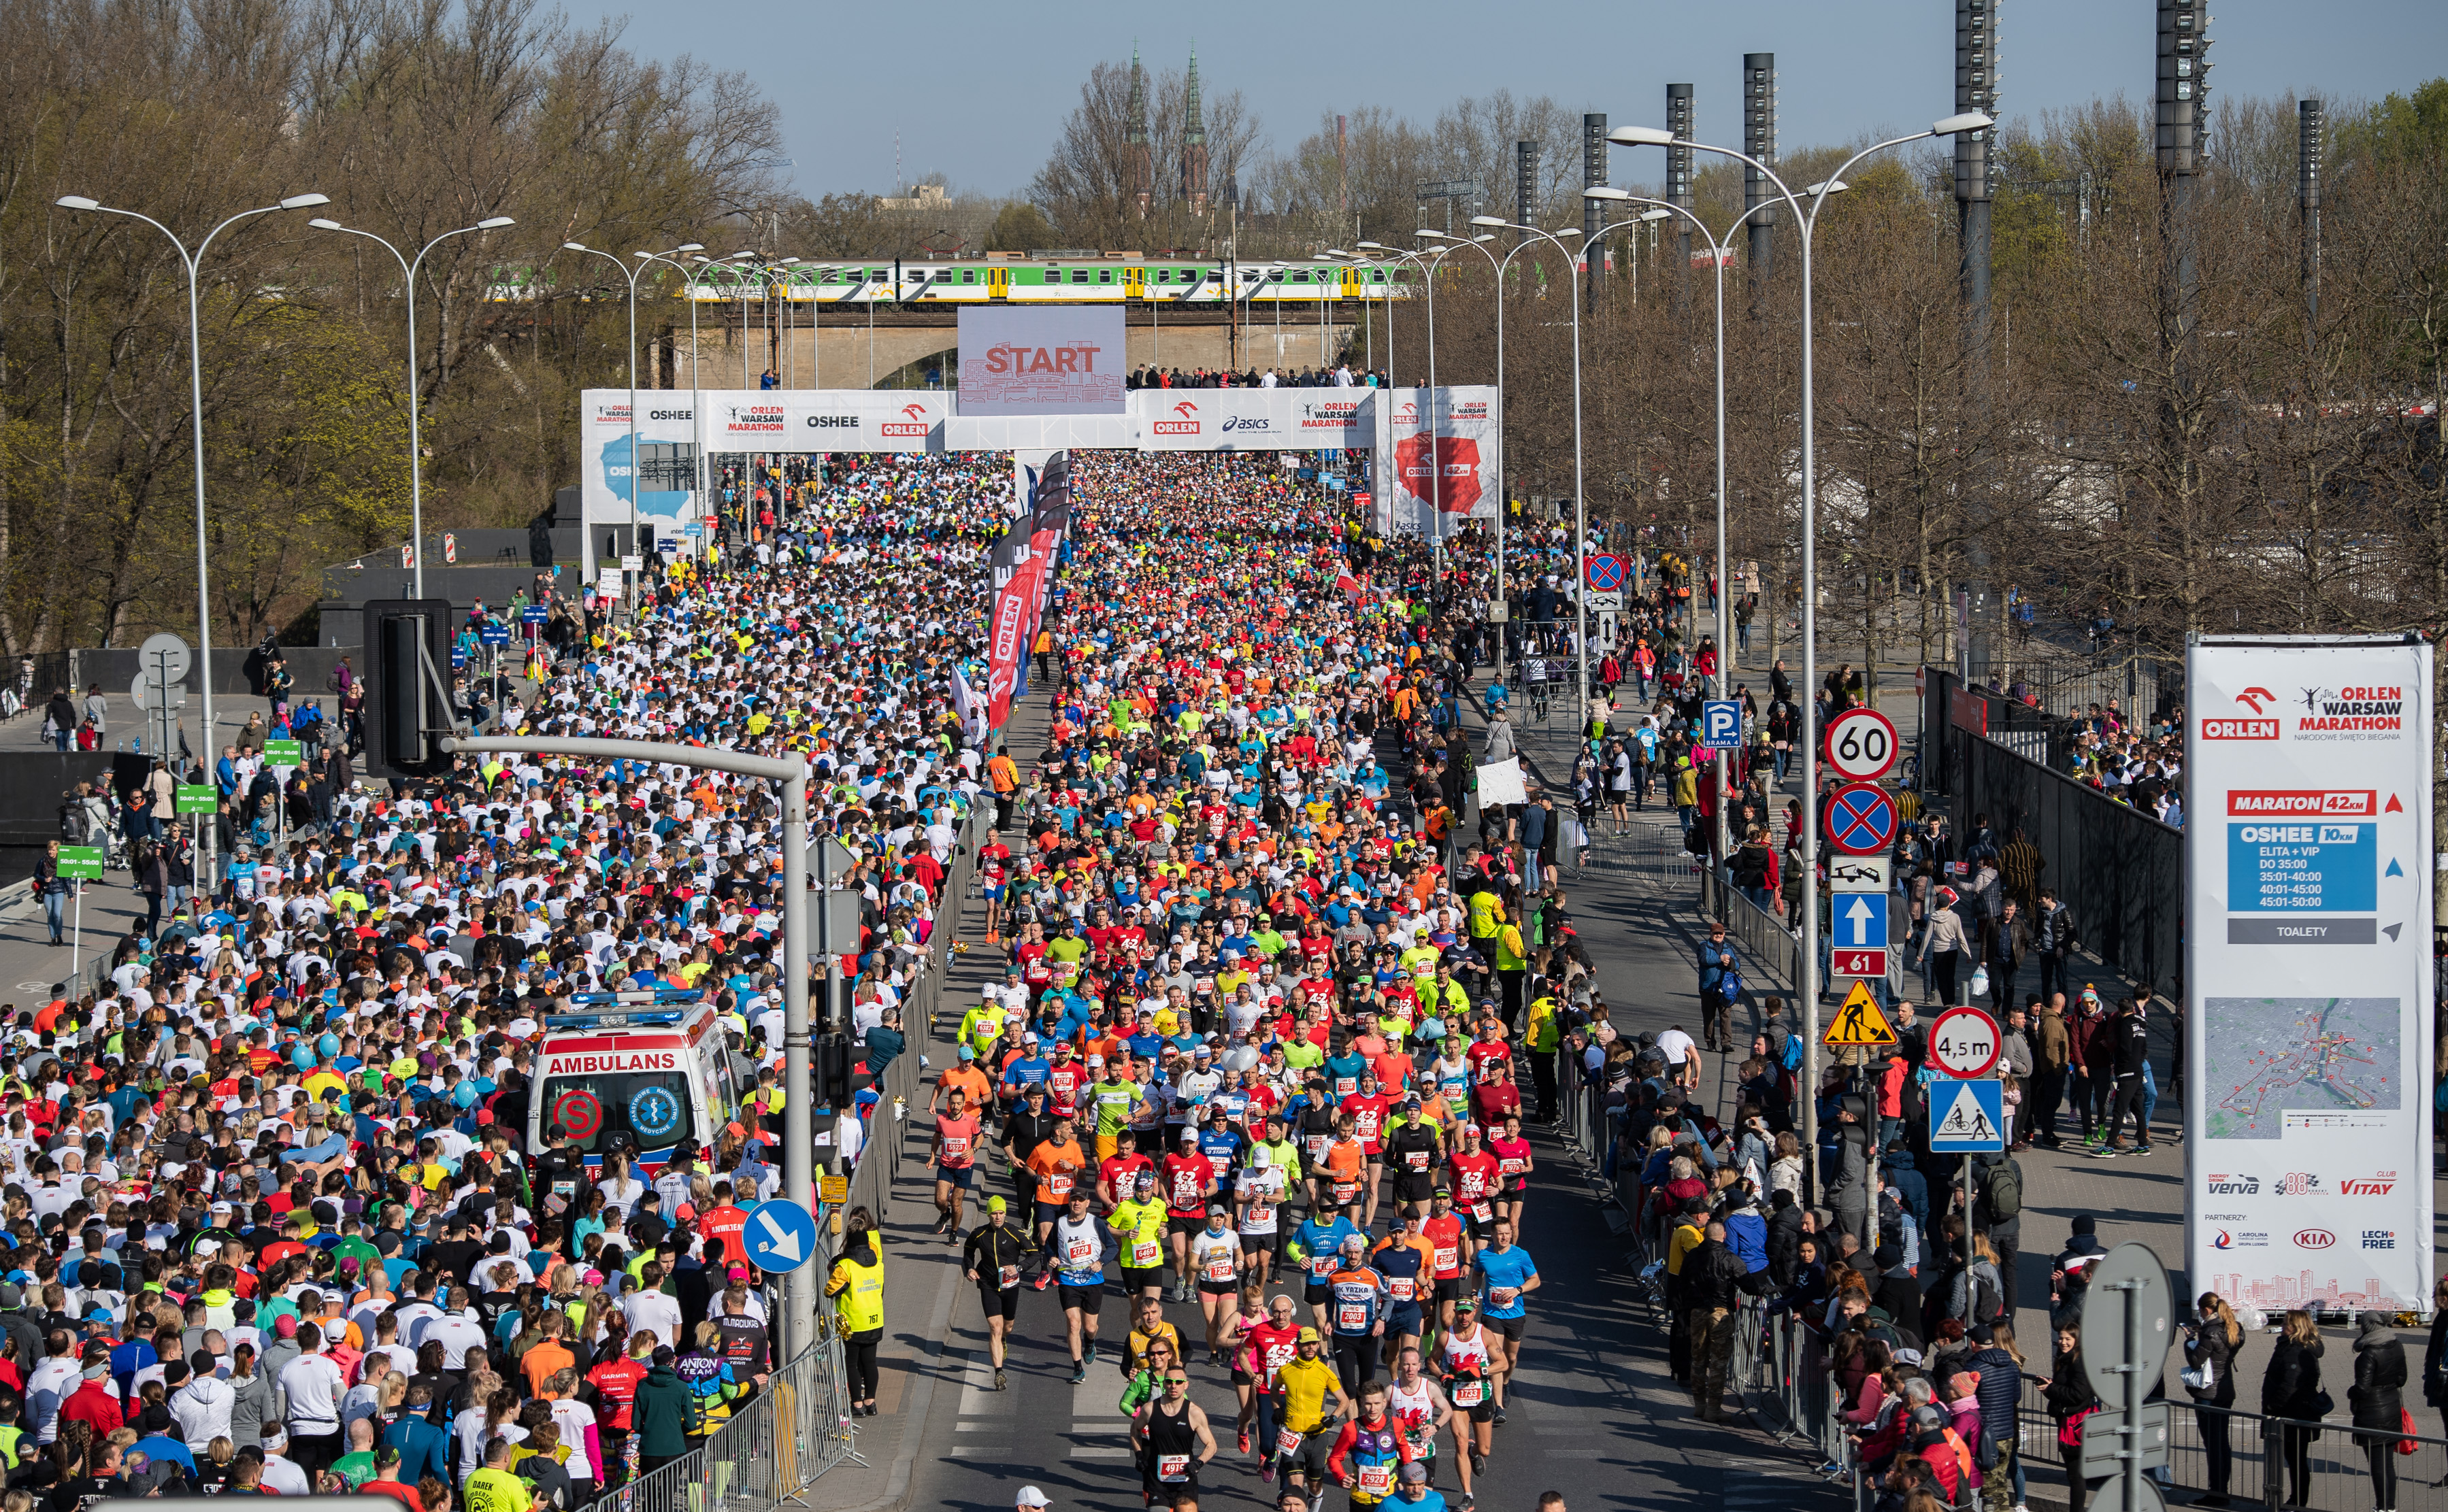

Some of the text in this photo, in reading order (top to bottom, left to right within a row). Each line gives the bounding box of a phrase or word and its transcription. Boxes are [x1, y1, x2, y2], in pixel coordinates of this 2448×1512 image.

[985, 347, 1101, 373] START
[750, 406, 784, 414] ORLEN
[1324, 402, 1357, 411] ORLEN
[650, 410, 693, 420] OSHEE
[1314, 411, 1357, 419] WARSAW
[728, 423, 784, 431] MARATHON
[807, 416, 859, 428] OSHEE
[1238, 419, 1270, 429] asics
[1302, 419, 1357, 427] MARATHON
[884, 425, 926, 435] ORLEN
[1155, 422, 1197, 433] ORLEN
[999, 599, 1020, 657] ORLEN
[2341, 686, 2401, 701] ORLEN
[2323, 702, 2402, 716] WARSAW
[1711, 714, 1733, 737] P
[2299, 717, 2401, 730] MARATHON
[2205, 722, 2276, 737] ORLEN
[2339, 733, 2366, 742] ŚWIĘTO
[1839, 726, 1887, 761] 60
[2234, 796, 2364, 810] MARATON 42KM
[2240, 826, 2353, 843] OSHEE 10KM
[2260, 847, 2290, 856] ELITA
[2300, 847, 2320, 856] VIP
[2260, 860, 2307, 869] DO 35:00
[2260, 872, 2322, 881] 35:01-40:00
[2260, 885, 2322, 894] 40:01-45:00
[2260, 897, 2322, 907] 45:01-50:00
[2277, 927, 2328, 937] TOALETY
[1850, 954, 1869, 971] 61
[1938, 1037, 1991, 1059] 4,5 m
[548, 1054, 675, 1074] AMBULANS
[632, 1088, 651, 1122] PAŃSTWOWE
[656, 1088, 677, 1120] RATOWNICTWO
[565, 1100, 590, 1130] S
[640, 1124, 671, 1135] MEDYCZNE
[1057, 1179, 1071, 1187] 4118
[2285, 1172, 2309, 1196] 88
[2341, 1178, 2398, 1195] VITAY
[2209, 1183, 2260, 1194] verva
[2300, 1233, 2329, 1245] KIA
[2362, 1230, 2388, 1239] LECH
[2362, 1240, 2395, 1249] FREE
[1073, 1246, 1089, 1256] 2728
[1138, 1248, 1154, 1257] 6469
[868, 1314, 878, 1324] 767
[1344, 1313, 1362, 1321] 2003
[680, 1358, 718, 1368] ANTON
[1460, 1388, 1478, 1397] 1733
[1279, 1432, 1295, 1446] 5263
[1364, 1475, 1385, 1484] 2928
[472, 1480, 494, 1491] DAREK
